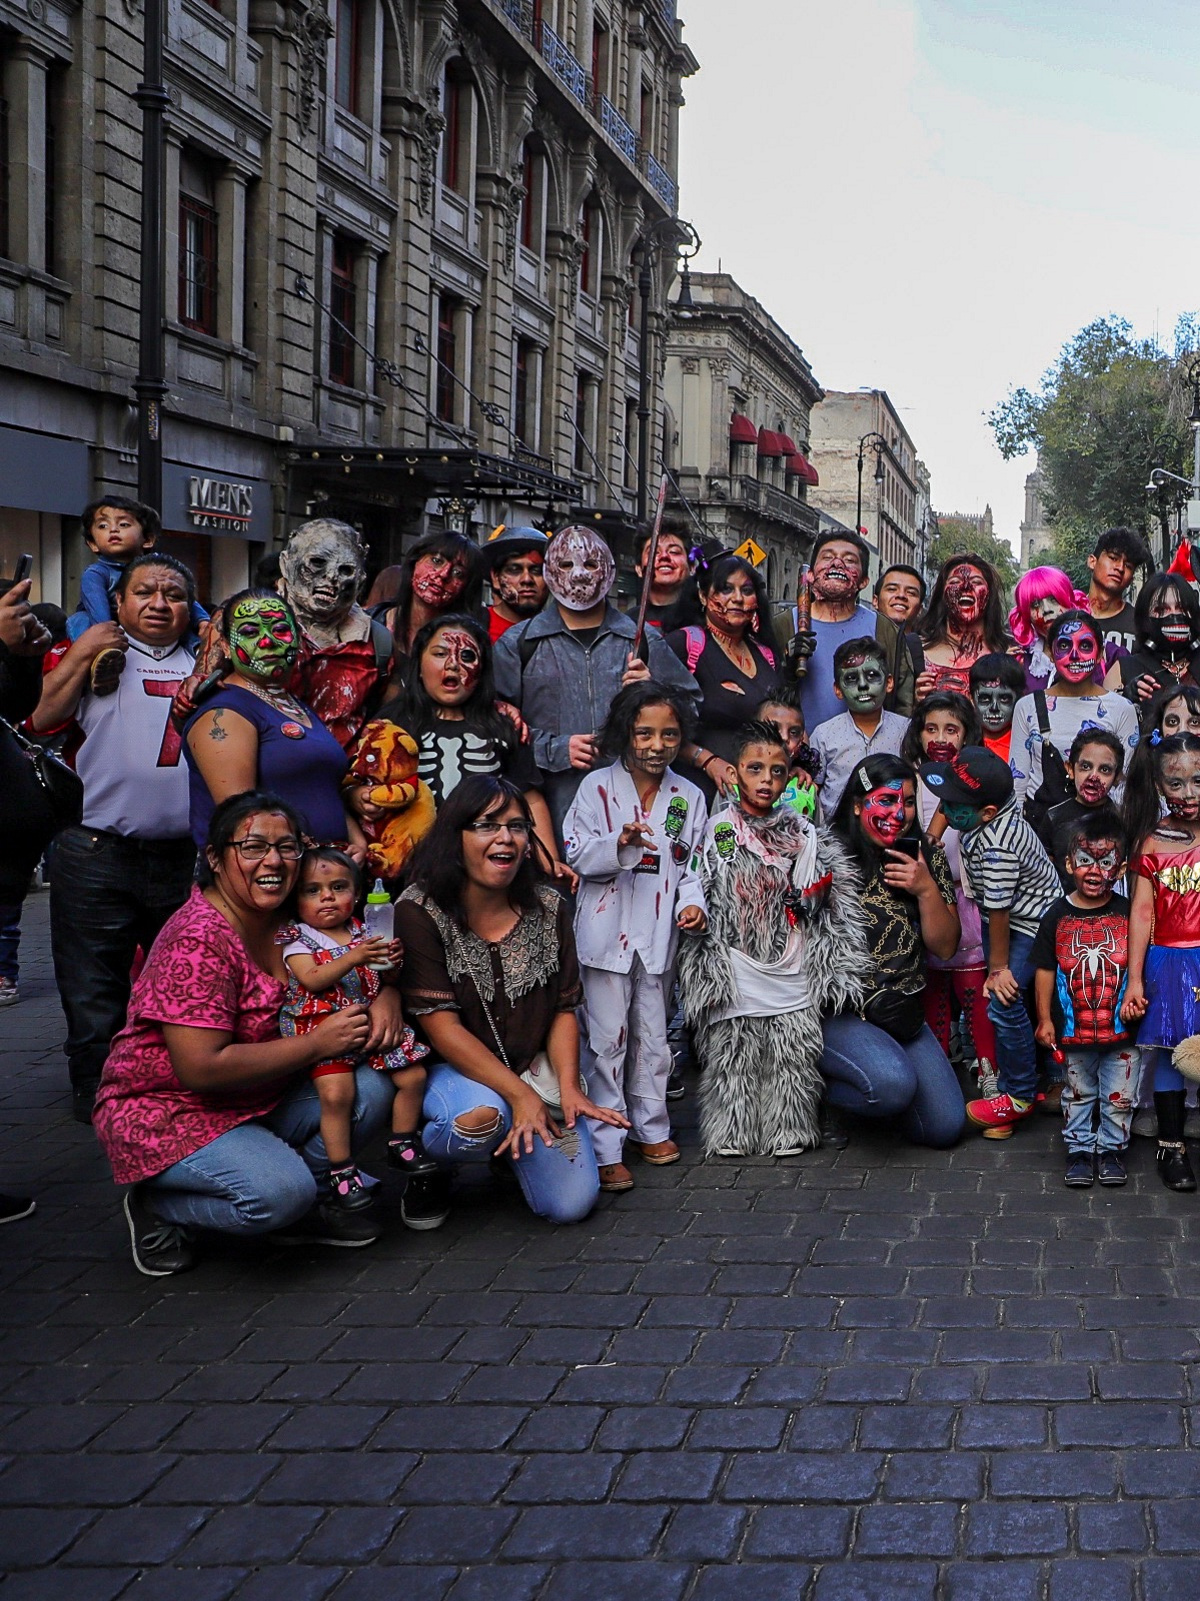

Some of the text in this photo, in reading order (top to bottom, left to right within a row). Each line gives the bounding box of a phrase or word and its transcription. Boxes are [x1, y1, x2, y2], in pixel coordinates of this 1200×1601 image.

[190, 475, 253, 516] MEN'S
[194, 515, 249, 531] FASHION
[136, 668, 187, 676] CARDINALS
[142, 679, 184, 768] 7
